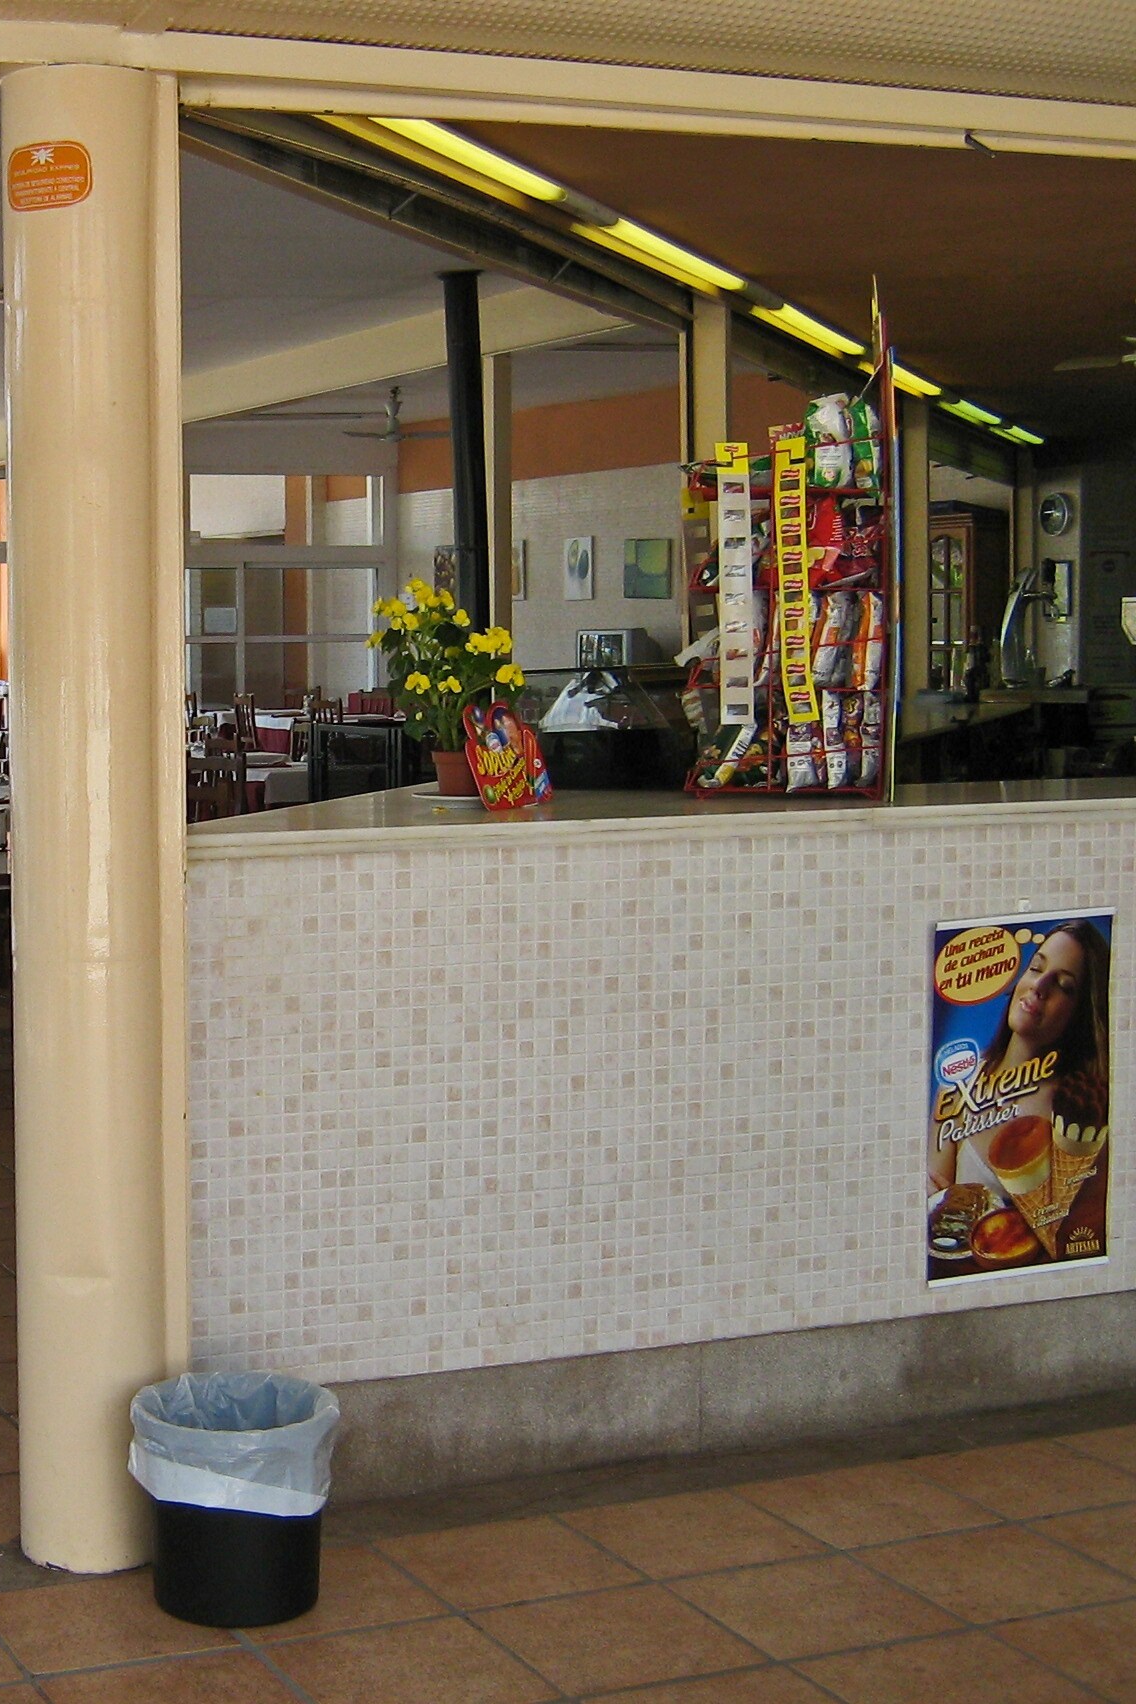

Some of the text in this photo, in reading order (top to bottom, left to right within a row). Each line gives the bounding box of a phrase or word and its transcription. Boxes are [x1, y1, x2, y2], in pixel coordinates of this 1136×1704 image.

[943, 943, 1005, 973] de cuchara
[944, 929, 1005, 958] Una receta
[939, 956, 1018, 991] en tu mano
